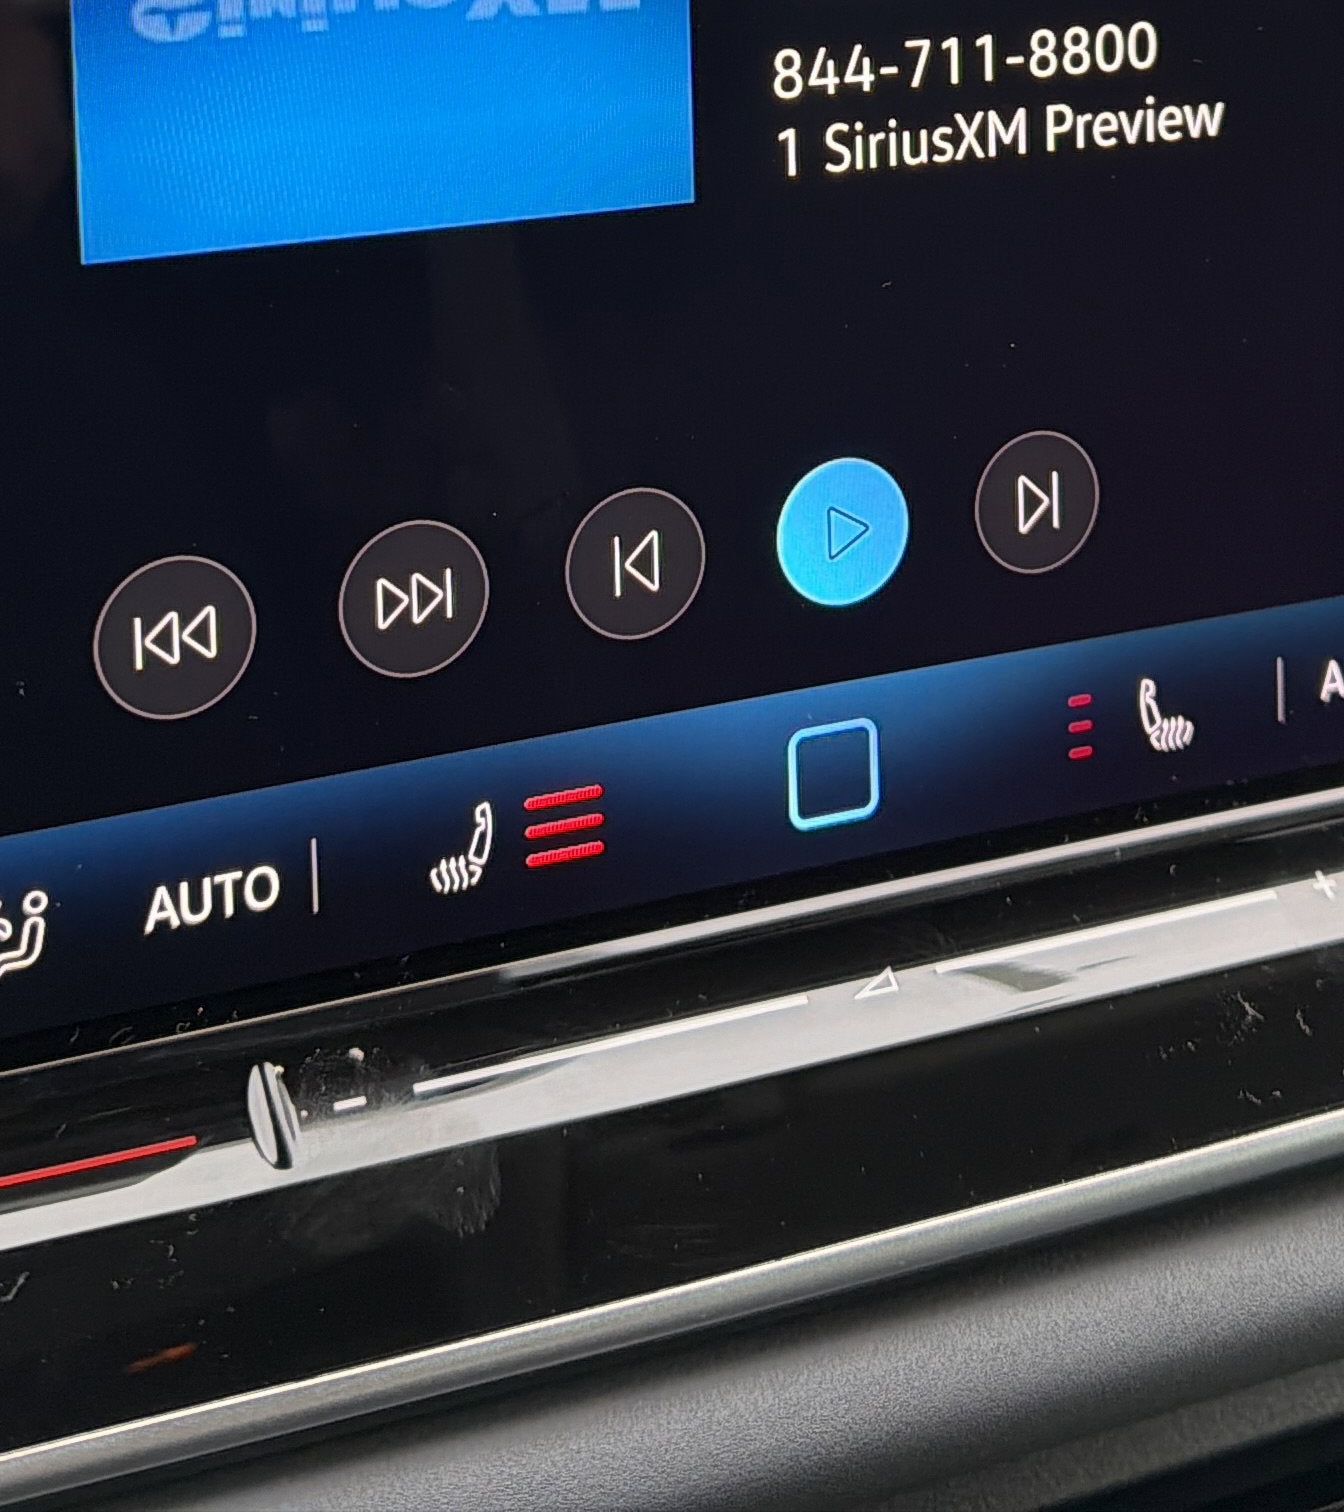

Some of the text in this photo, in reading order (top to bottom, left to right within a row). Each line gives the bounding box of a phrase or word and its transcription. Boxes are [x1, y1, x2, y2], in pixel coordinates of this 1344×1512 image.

[772, 20, 1159, 100] 844-711-8800
[776, 95, 1225, 178] 1 SiriusXM Preview
[143, 865, 281, 935] AUTO
